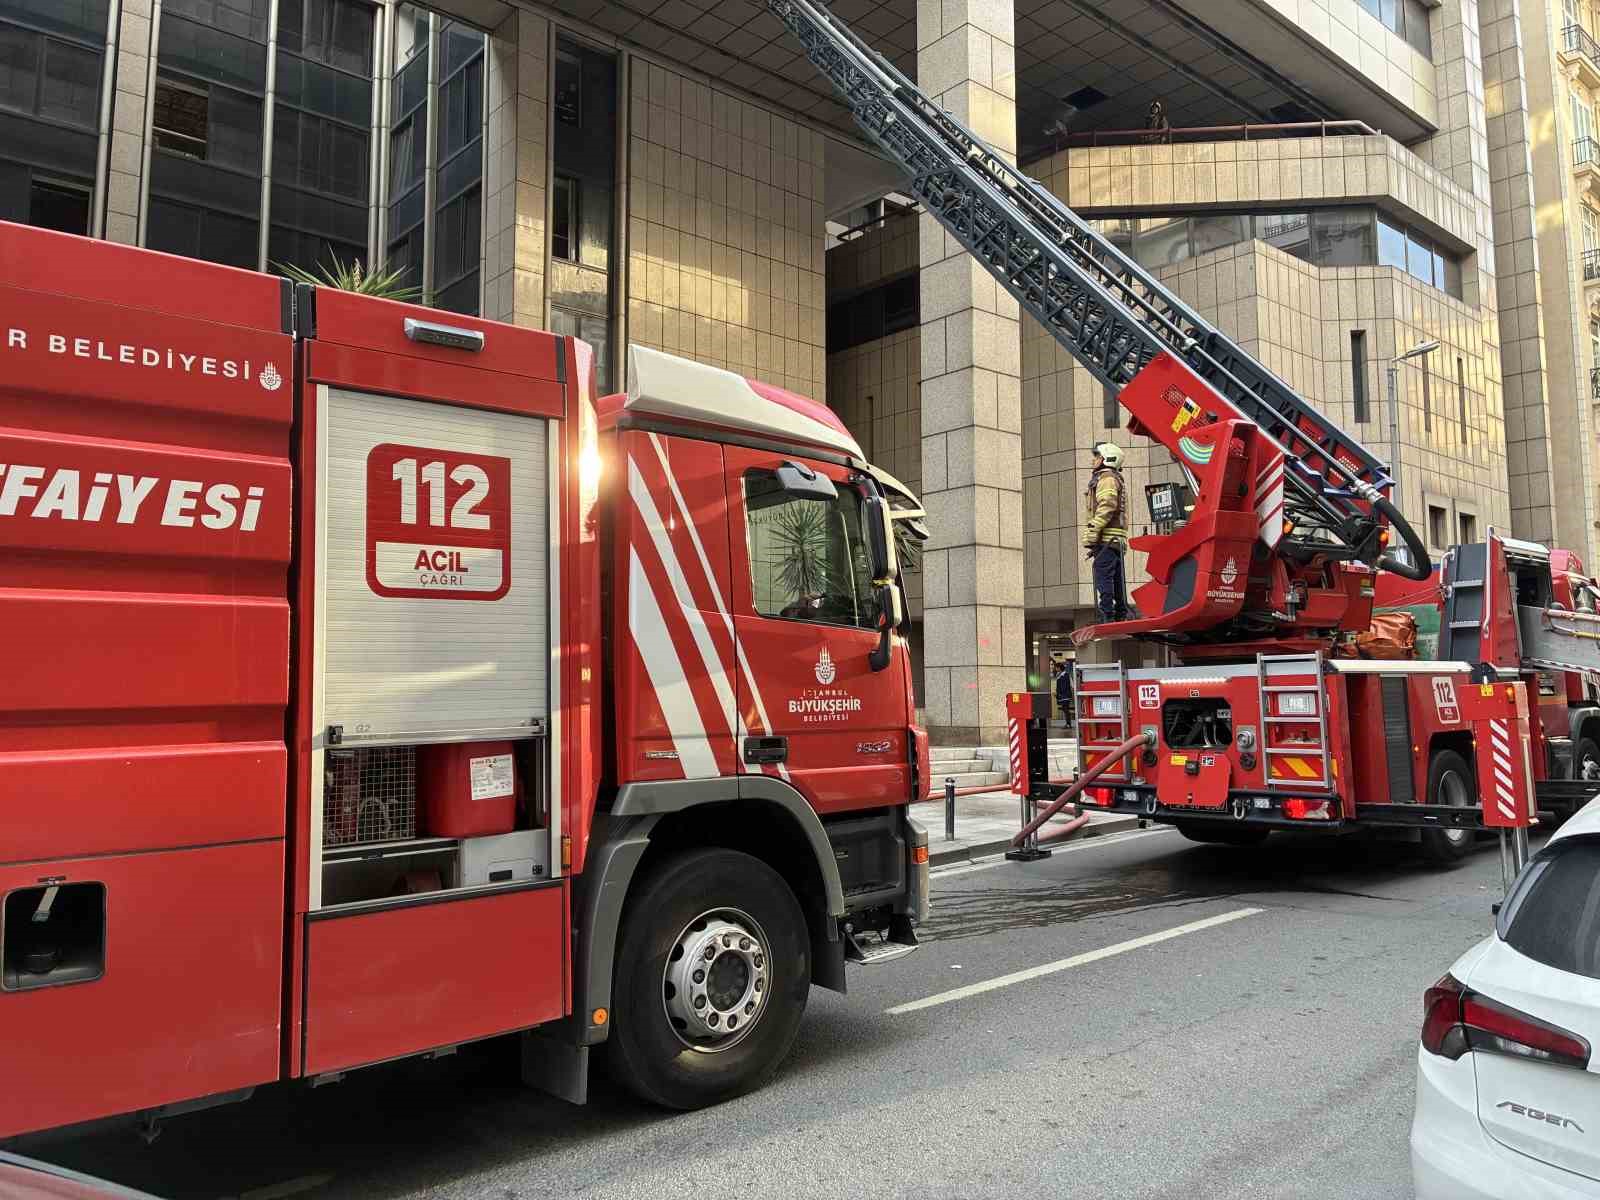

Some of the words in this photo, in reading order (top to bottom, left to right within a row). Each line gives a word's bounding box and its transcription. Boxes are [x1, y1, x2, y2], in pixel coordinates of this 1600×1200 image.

[49, 334, 250, 380] BELEDİYESİ
[0, 463, 265, 532] FAİYESİ
[392, 457, 491, 531] 112
[414, 549, 469, 574] ACİL
[419, 574, 464, 587] ÇAĞRI
[1141, 686, 1157, 699] 112
[1436, 682, 1455, 704] 112
[788, 695, 862, 715] BÜYÜKŞEHİR
